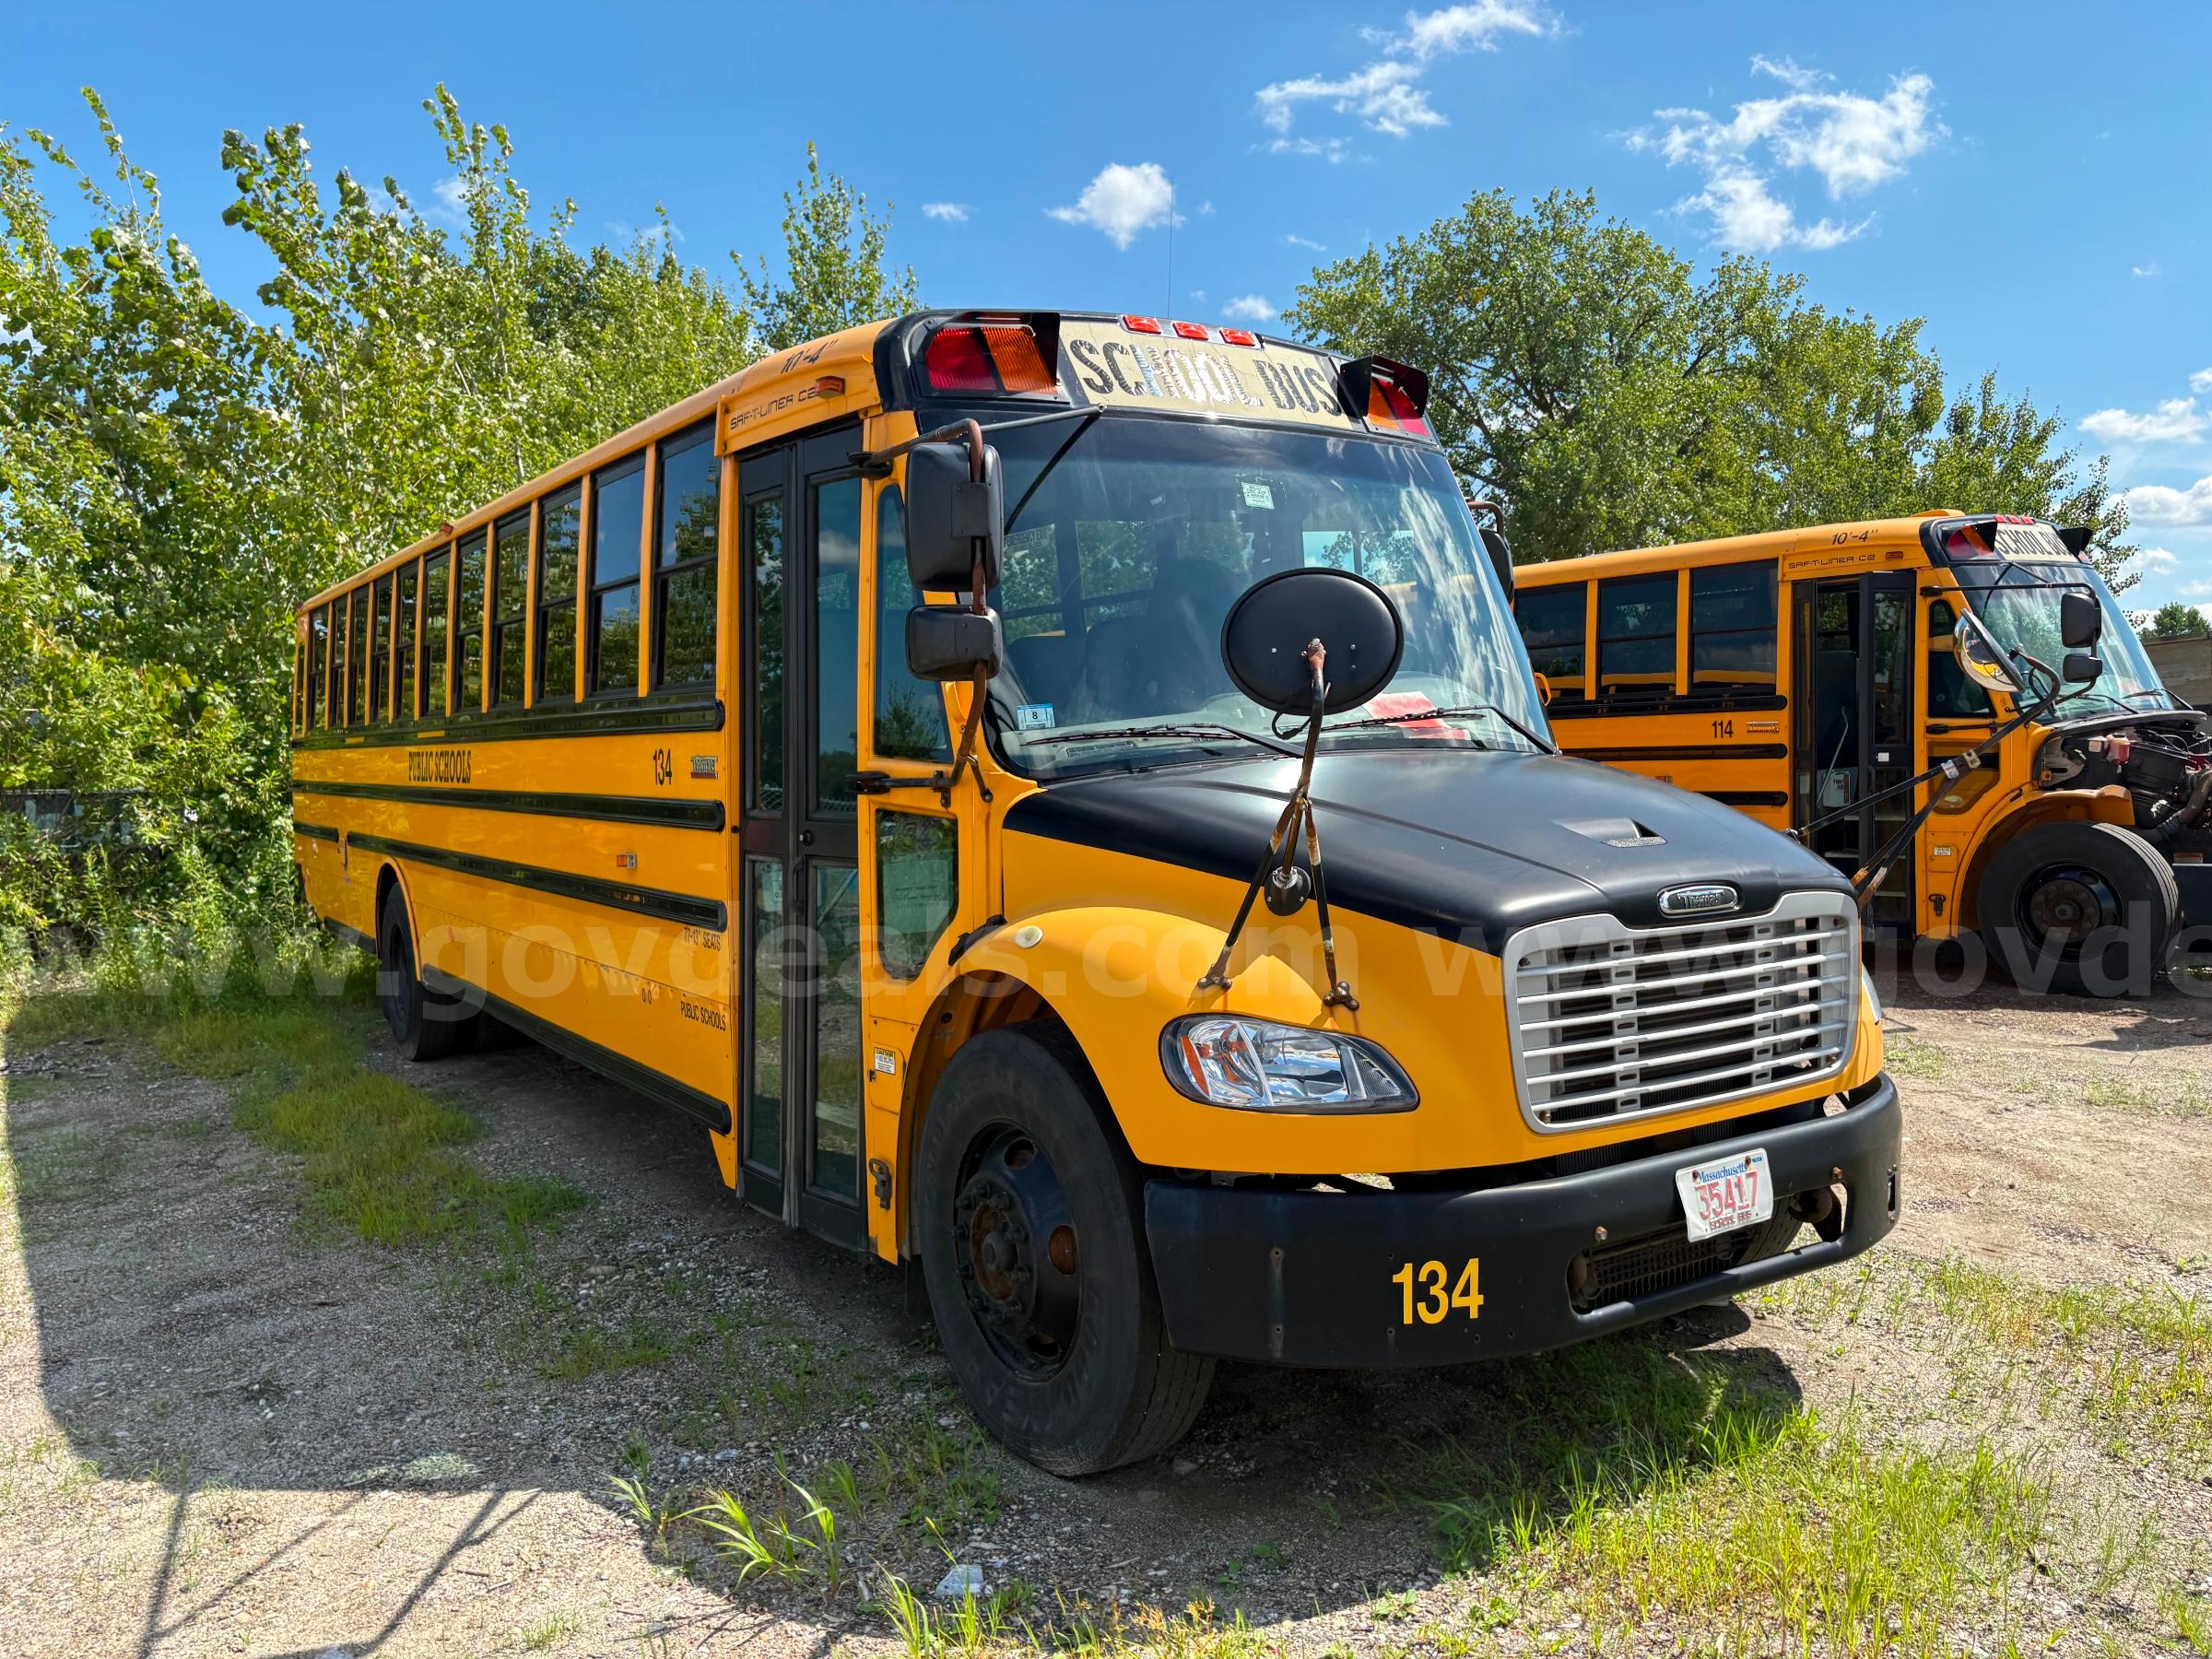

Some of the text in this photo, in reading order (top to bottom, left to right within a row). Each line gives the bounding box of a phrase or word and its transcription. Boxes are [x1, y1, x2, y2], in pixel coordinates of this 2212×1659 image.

[1069, 339, 1343, 416] SCHOOL BUS
[1995, 529, 2046, 555] SCHOOL
[1712, 720, 1734, 738] 114
[408, 750, 471, 783] PUBLIC SCHOOLS
[653, 748, 673, 785] 134
[702, 931, 721, 951] SEATS
[680, 1001, 726, 1031] PUBLIC SCHOOLS
[1698, 1162, 1748, 1182] Massachusetts
[1695, 1171, 1759, 1221] 35417
[1392, 1256, 1485, 1325] 134
